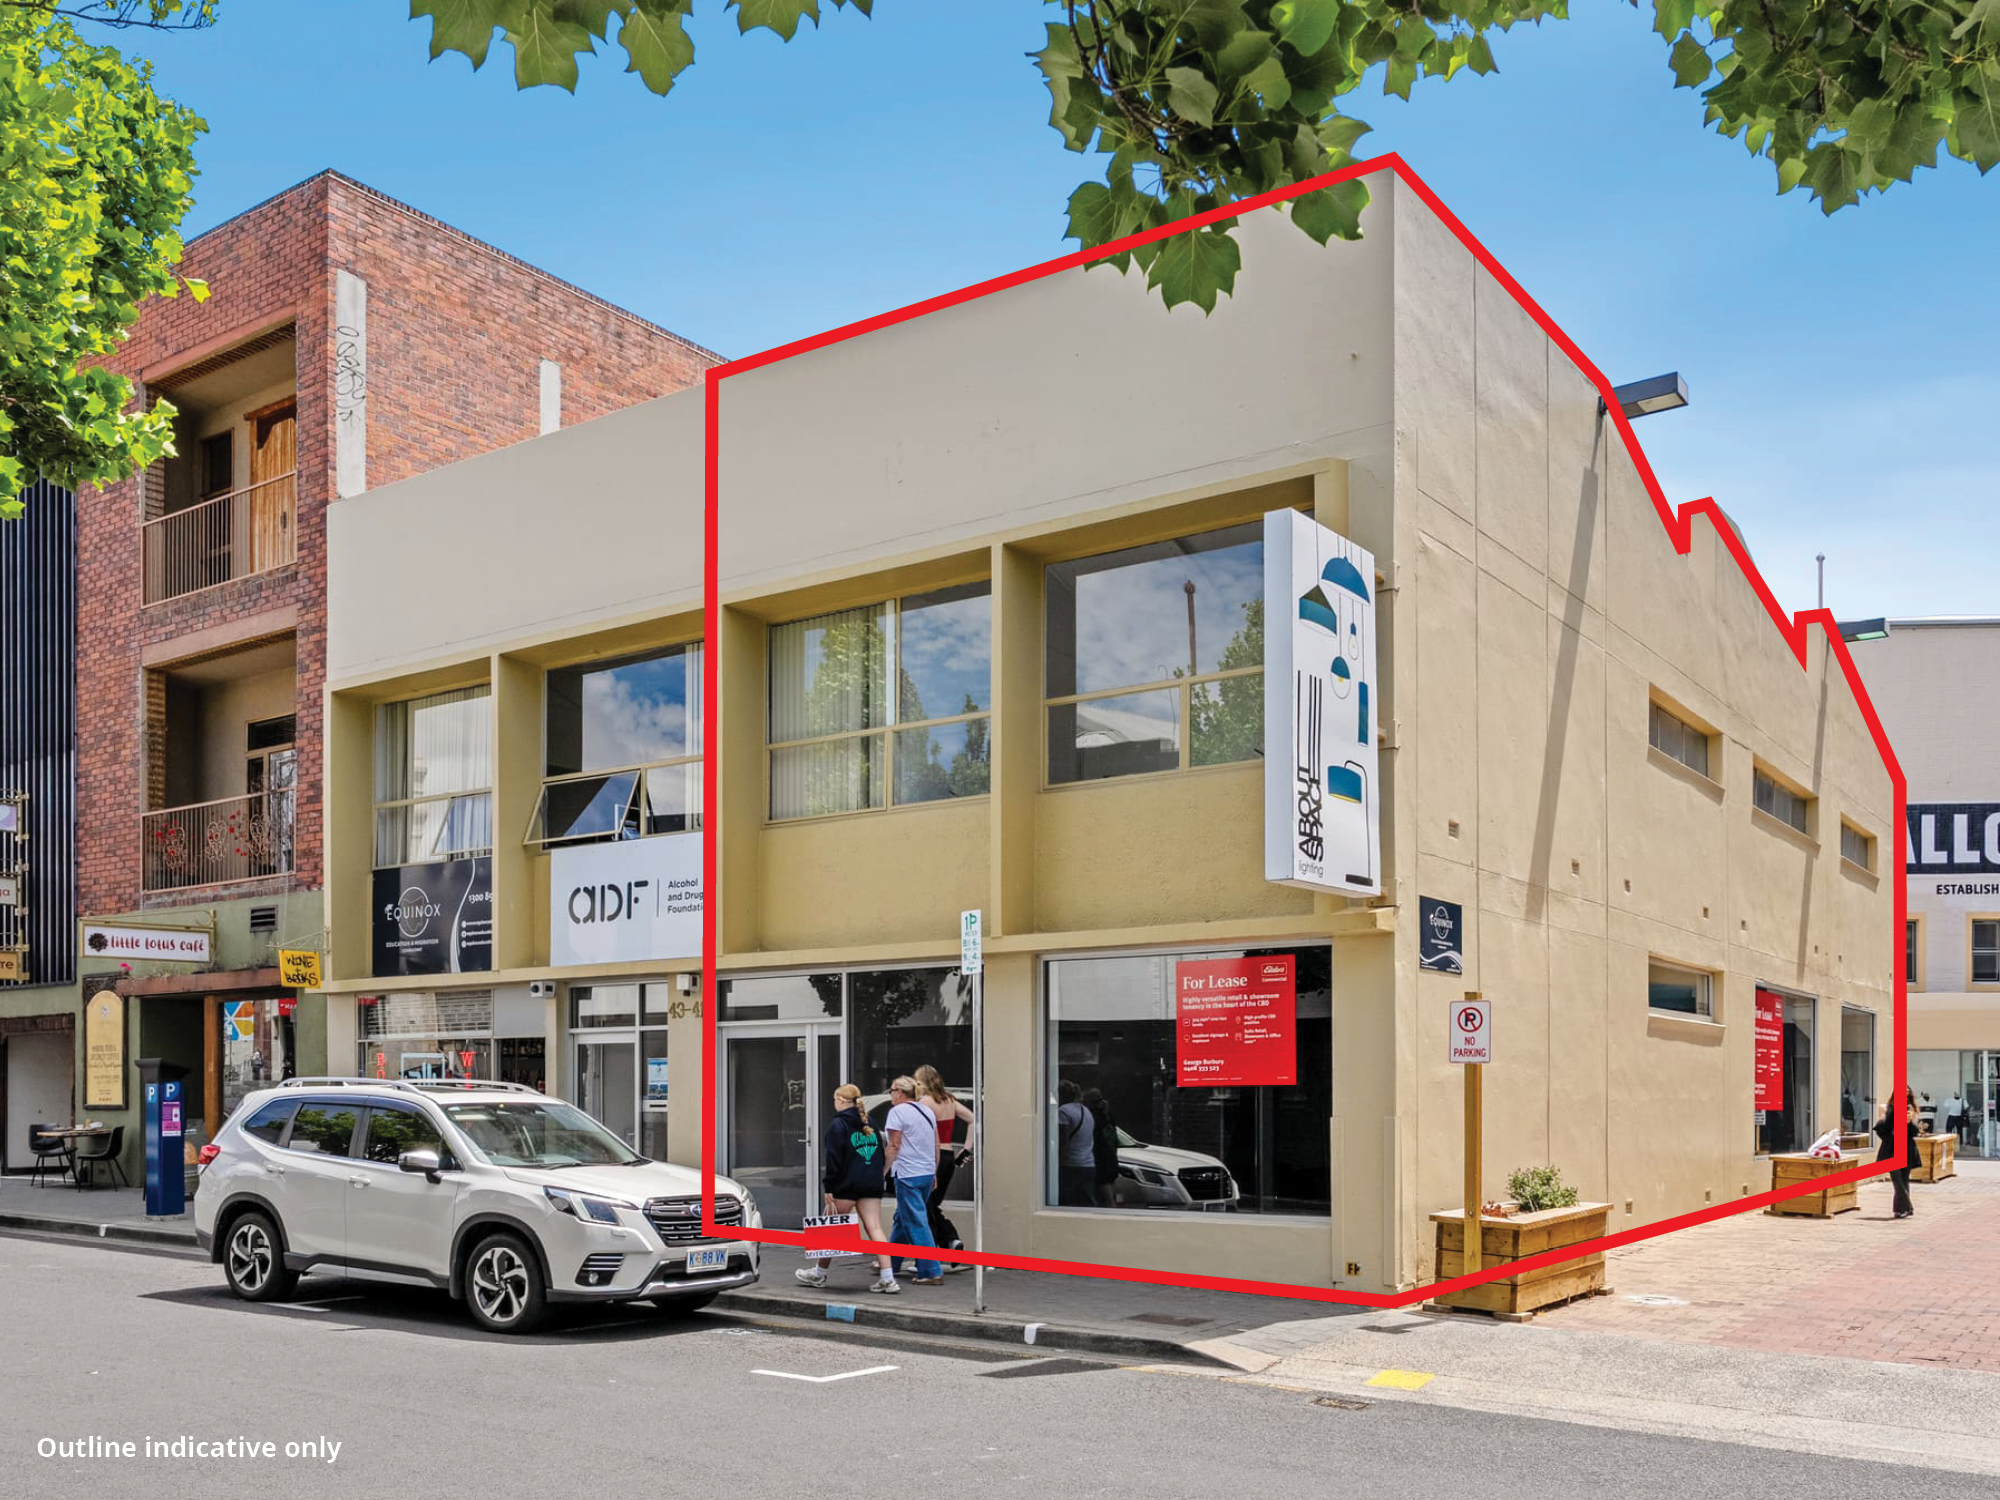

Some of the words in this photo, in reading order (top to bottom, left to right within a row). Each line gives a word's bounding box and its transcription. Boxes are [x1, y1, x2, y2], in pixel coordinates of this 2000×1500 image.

[1298, 860, 1324, 878] lighting
[668, 879, 699, 889] Alcohol
[1936, 884, 2000, 895] ESTABLISH
[668, 893, 683, 902] and
[684, 890, 703, 901] Drug
[385, 903, 441, 922] EQUINOX
[110, 935, 140, 949] little
[145, 937, 175, 951] lotus
[179, 938, 205, 952] café
[1183, 976, 1205, 990] For
[1208, 975, 1248, 989] Lease
[1464, 1036, 1476, 1046] NO
[1453, 1047, 1487, 1058] PARKING
[148, 1086, 155, 1101] P
[165, 1083, 176, 1098] P
[804, 1215, 850, 1226] MYER
